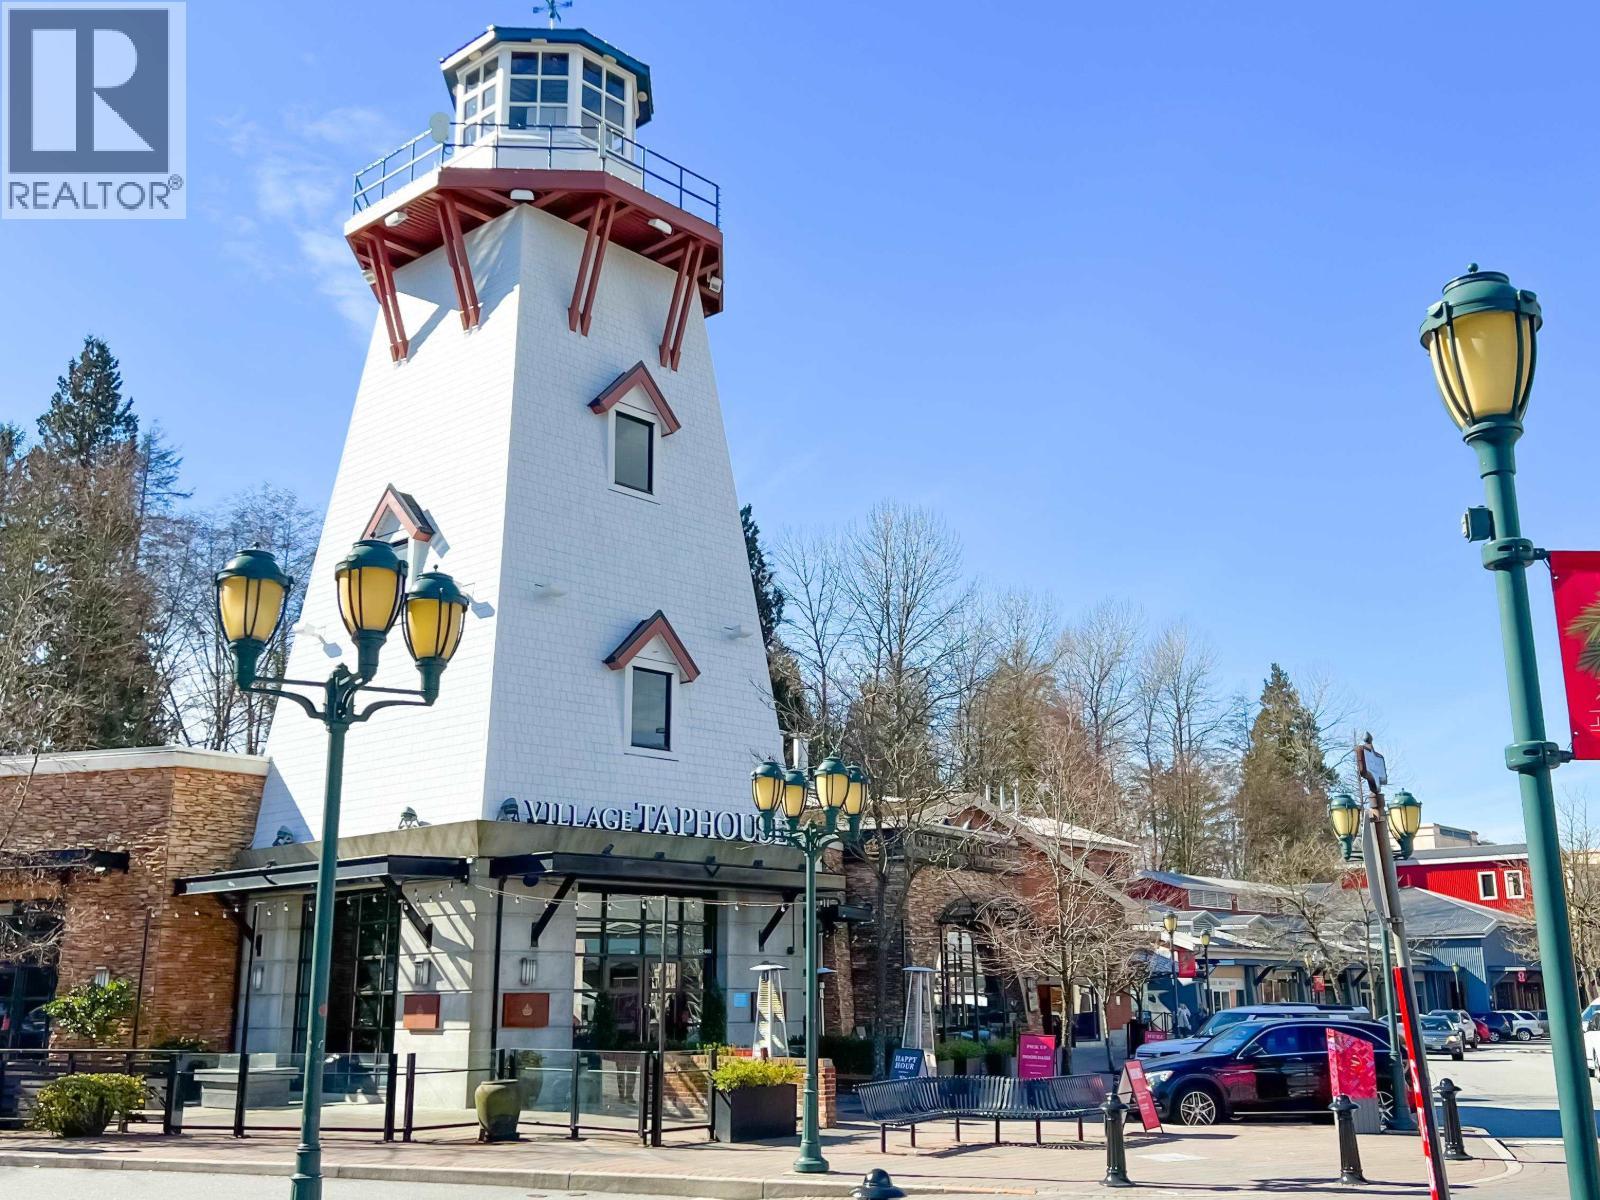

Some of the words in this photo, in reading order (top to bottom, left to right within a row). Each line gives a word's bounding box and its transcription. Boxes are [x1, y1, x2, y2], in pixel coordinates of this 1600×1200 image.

[525, 800, 633, 831] VILLAGE
[894, 1055, 918, 1064] HAPPY
[894, 1062, 915, 1070] HOUR
